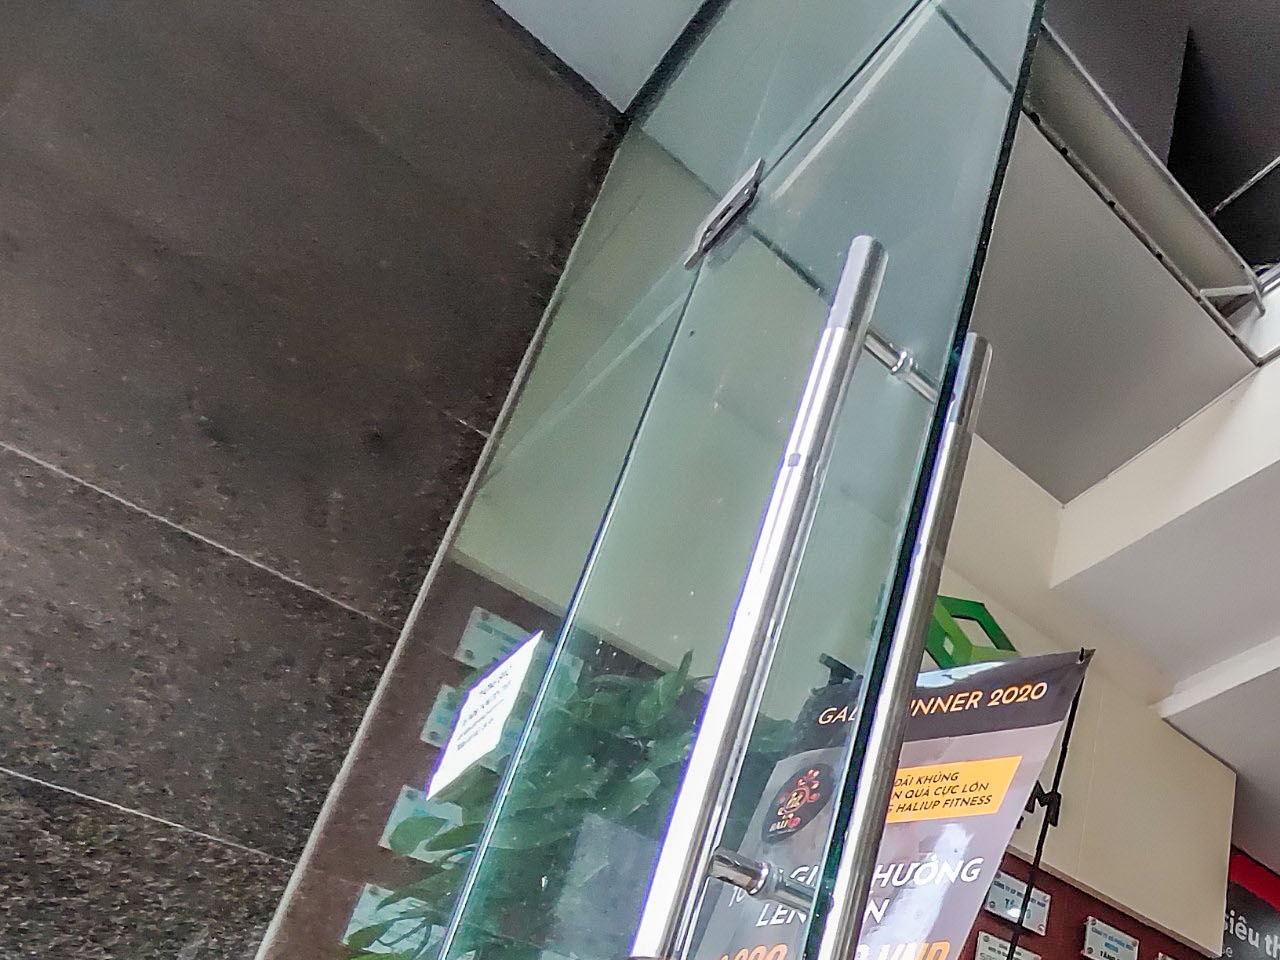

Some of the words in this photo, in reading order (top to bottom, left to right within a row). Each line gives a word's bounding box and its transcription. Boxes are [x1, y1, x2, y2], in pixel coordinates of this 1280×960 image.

[909, 690, 983, 717] INNER
[987, 682, 1048, 707] 2020
[896, 800, 940, 813] HALIUP
[942, 795, 992, 808] FITNESS
[870, 854, 984, 887] HƯỞNG
[1223, 909, 1260, 948] iêu
